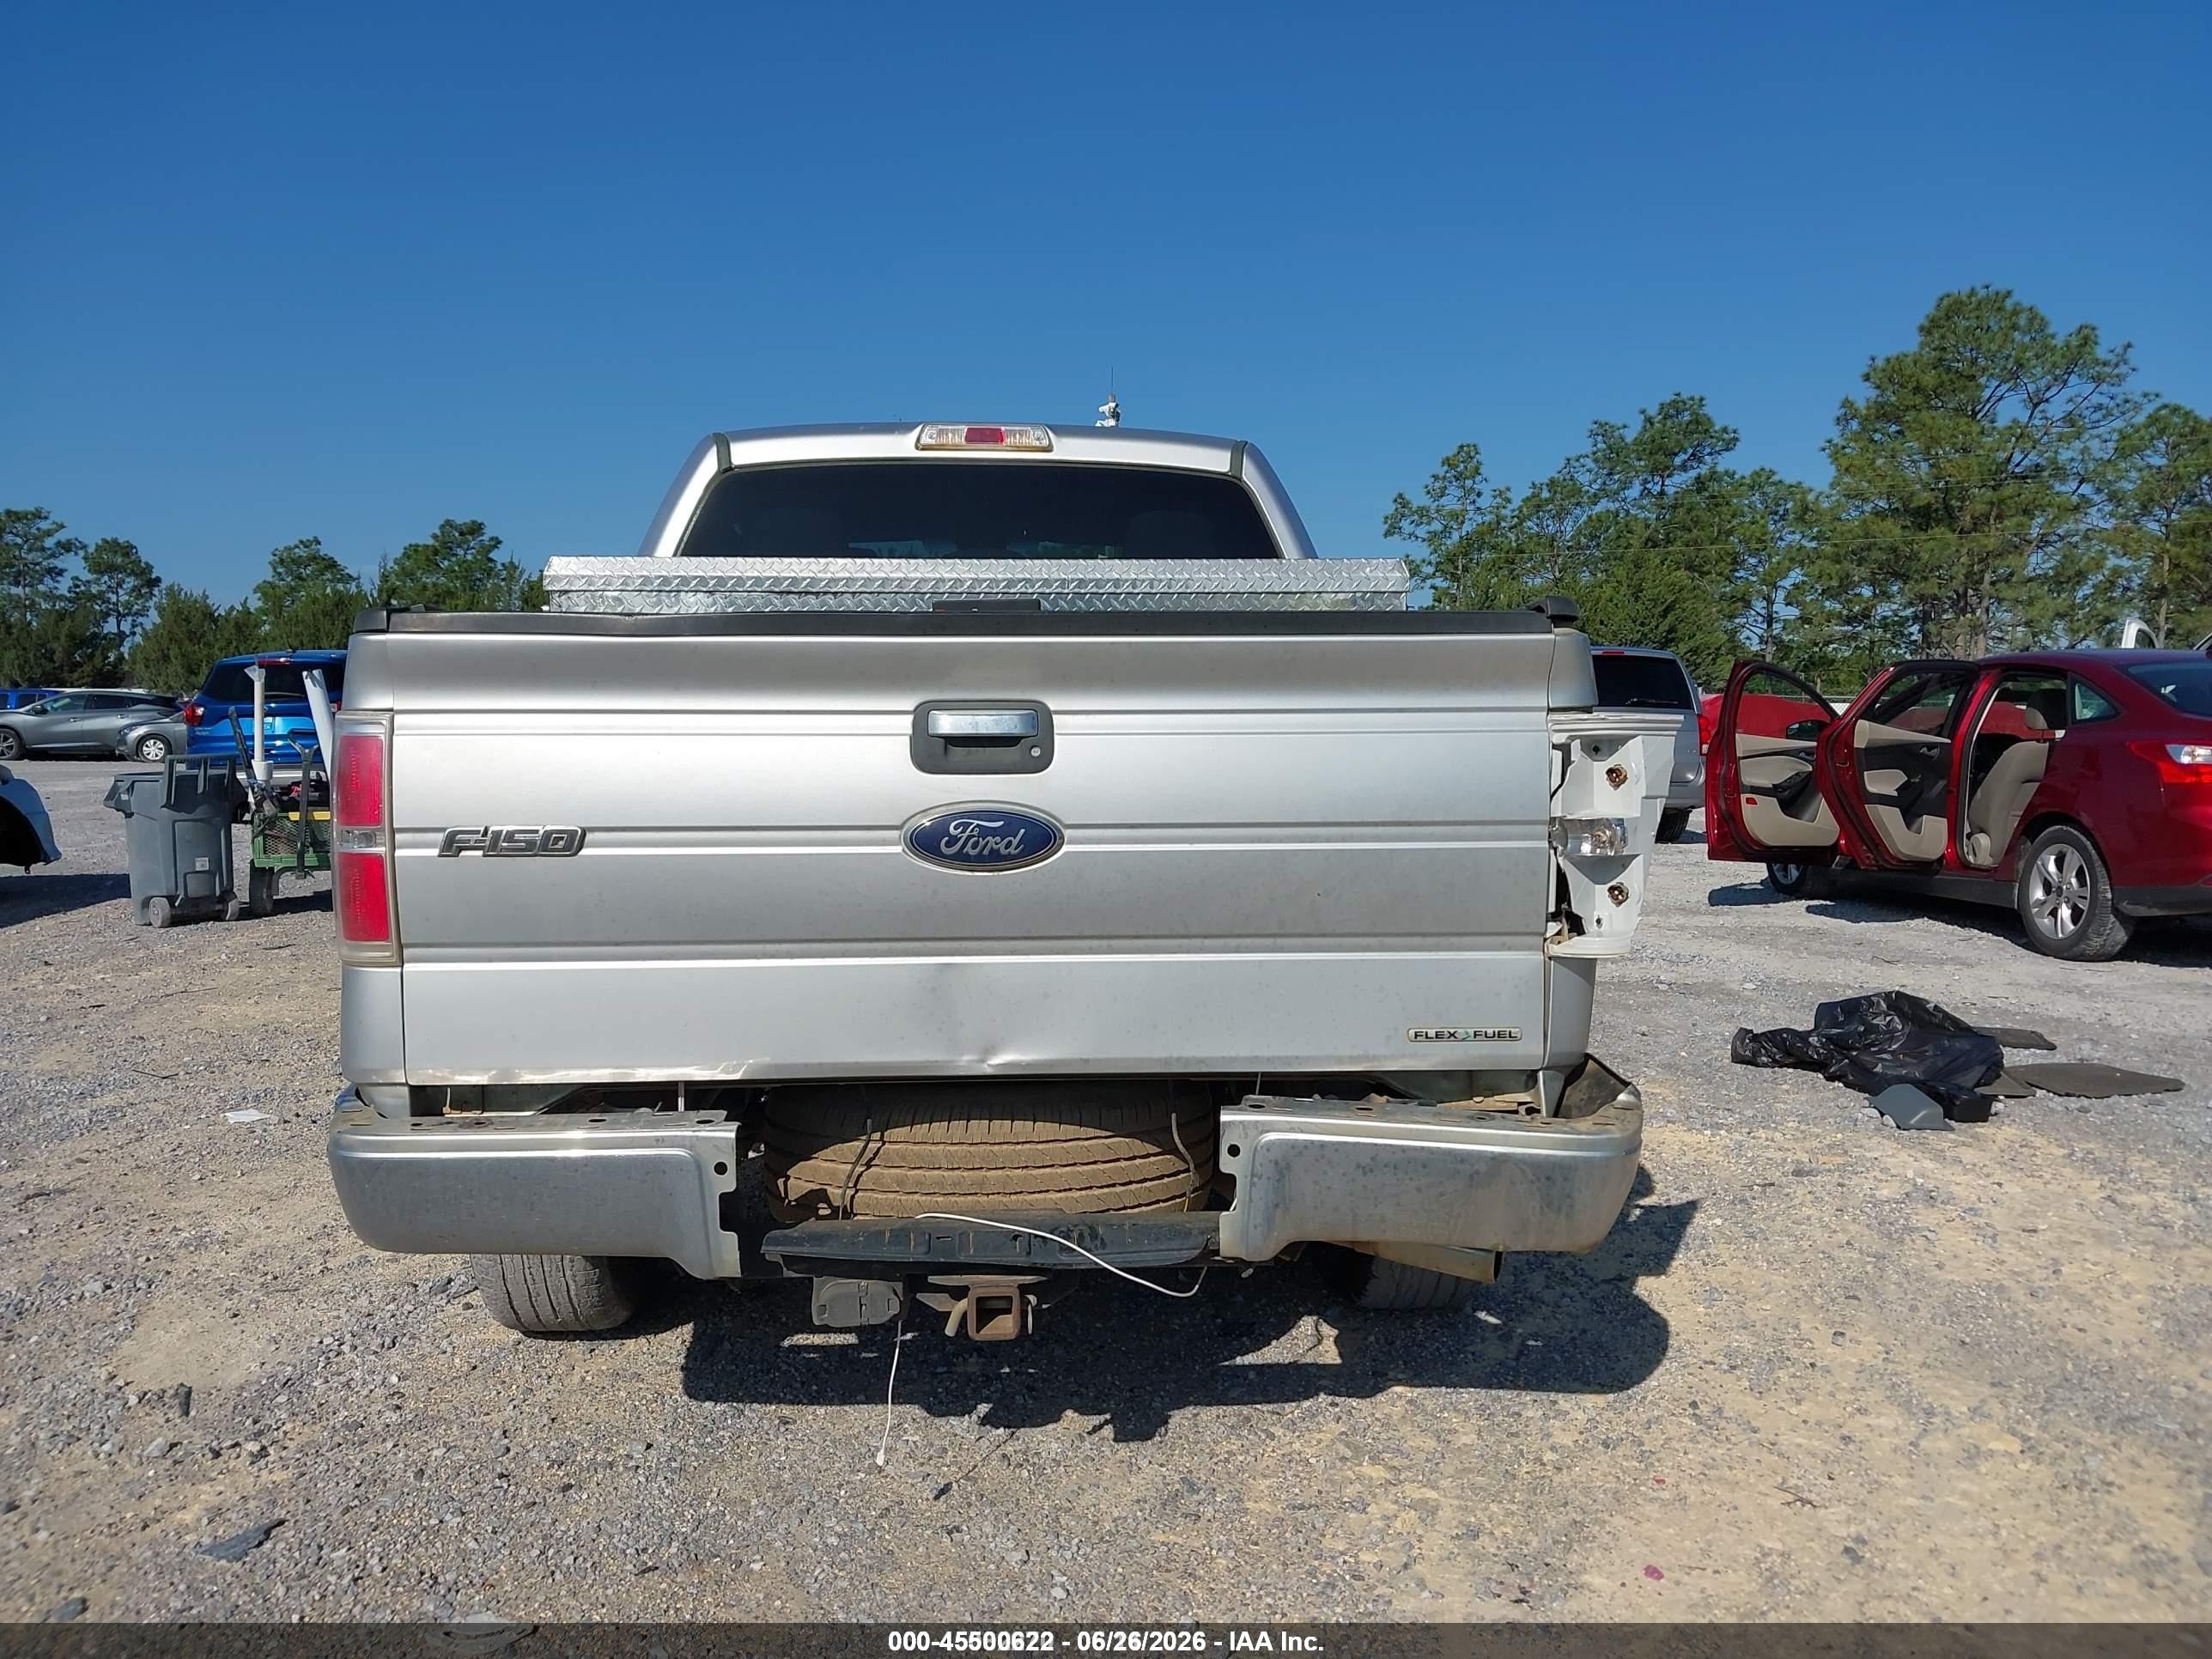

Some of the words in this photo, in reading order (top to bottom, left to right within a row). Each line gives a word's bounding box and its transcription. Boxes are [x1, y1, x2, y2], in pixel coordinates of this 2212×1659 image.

[438, 826, 586, 858] F-150
[940, 818, 1026, 856] Ford
[1413, 1030, 1459, 1040] FLEX
[1473, 1030, 1519, 1039] FUEL
